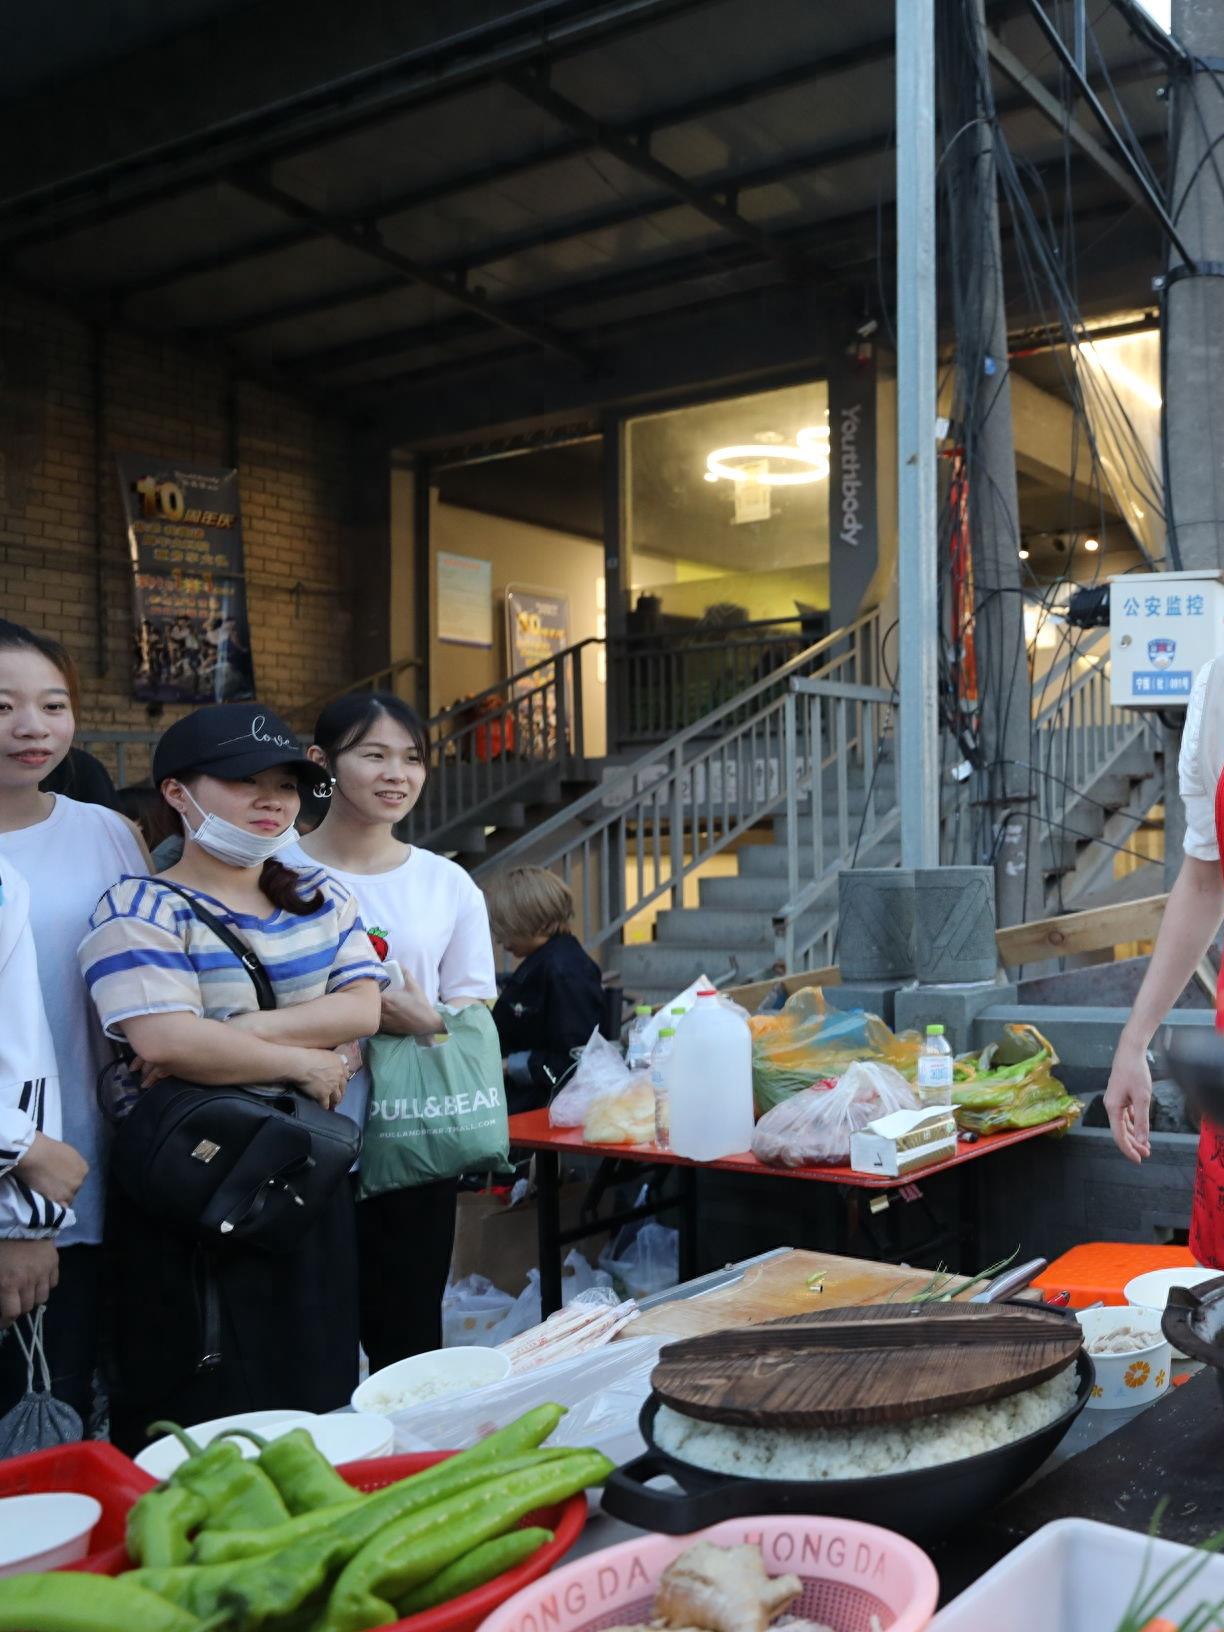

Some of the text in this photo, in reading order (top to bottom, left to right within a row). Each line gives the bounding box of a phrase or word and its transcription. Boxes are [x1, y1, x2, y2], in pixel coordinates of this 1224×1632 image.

[840, 404, 863, 546] Youthbody
[1123, 594, 1204, 616] 公安监控
[220, 715, 299, 750] love
[369, 1087, 501, 1121] PULL&BEAR
